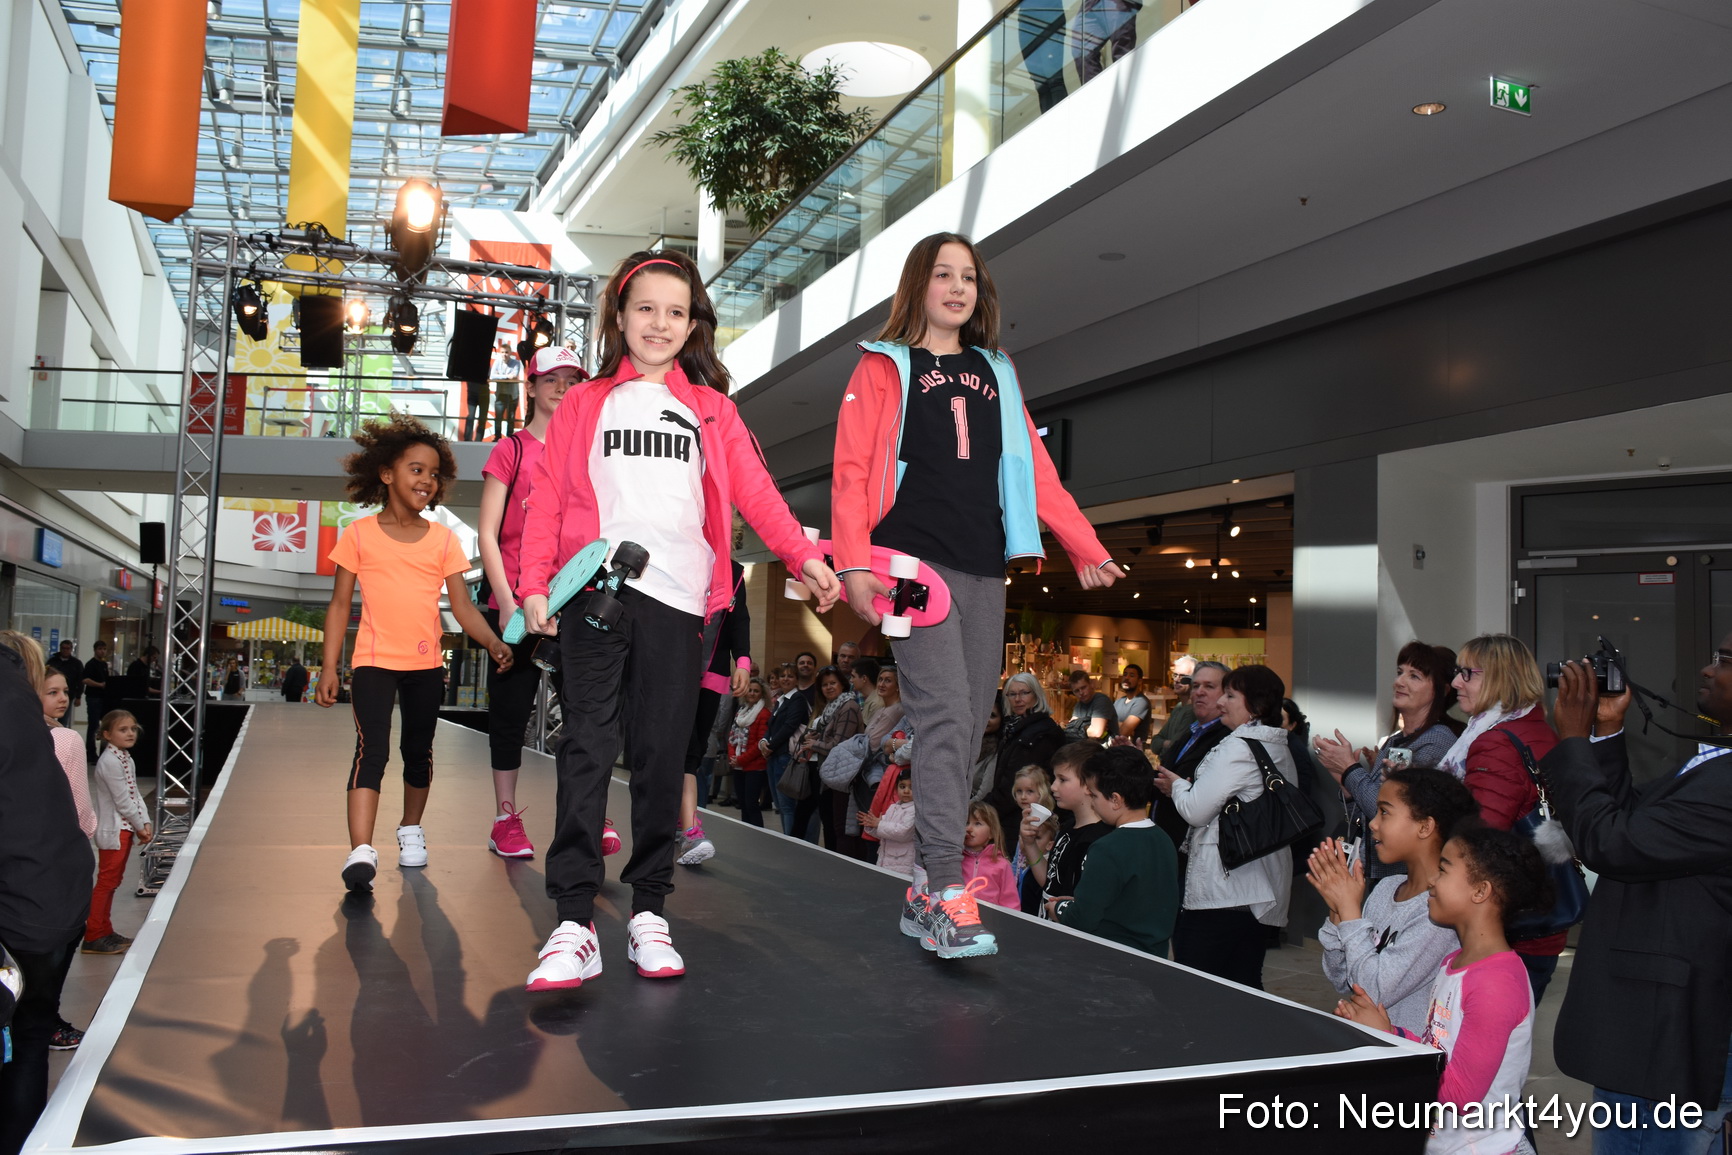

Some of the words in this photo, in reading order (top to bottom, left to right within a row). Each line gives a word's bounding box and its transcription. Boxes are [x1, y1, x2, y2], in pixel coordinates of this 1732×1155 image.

[958, 372, 980, 390] DO
[982, 384, 998, 401] IT
[951, 396, 970, 460] 1
[603, 429, 691, 463] PUMA
